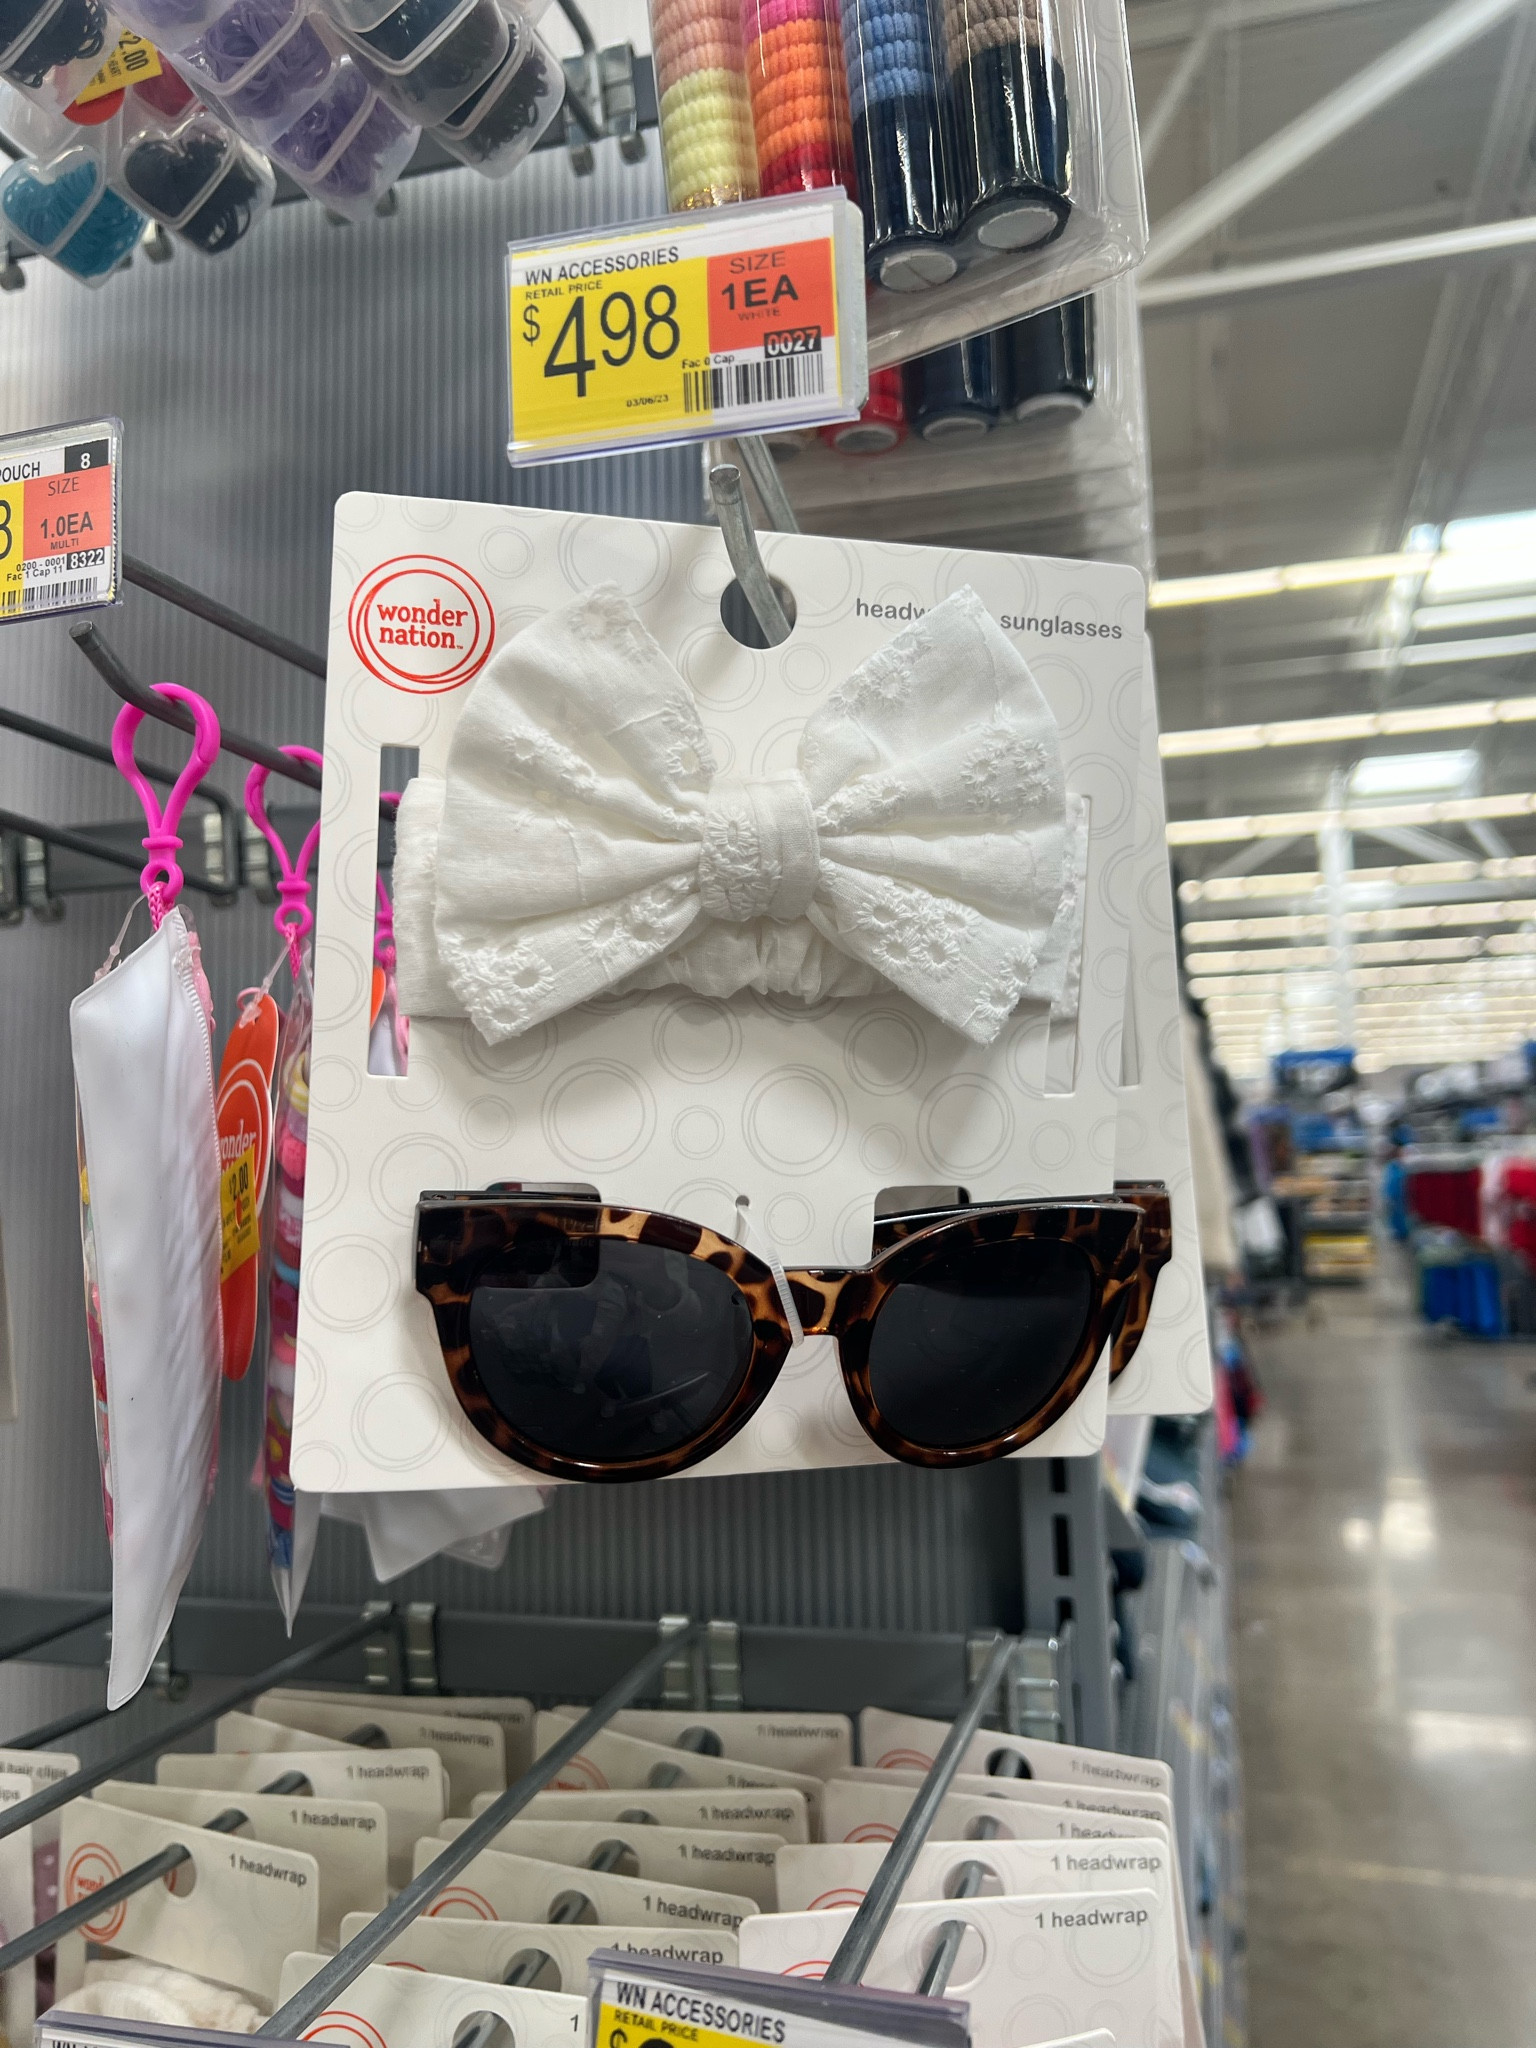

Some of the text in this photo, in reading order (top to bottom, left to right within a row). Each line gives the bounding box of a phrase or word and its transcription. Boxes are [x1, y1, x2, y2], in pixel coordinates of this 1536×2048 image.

[525, 246, 679, 286] WN ACCESSORIES
[729, 250, 786, 274] SIZE
[525, 280, 603, 300] RETAIL PRICE
[722, 274, 799, 310] 1EA
[738, 308, 781, 321] WHITE
[767, 329, 818, 356] 0027
[682, 358, 701, 369] Fac
[714, 354, 735, 366] Cap
[80, 452, 91, 470] 8
[48, 476, 80, 497] SIZE
[40, 511, 94, 539] 1.0EA
[50, 539, 79, 550] MULTI
[16, 561, 37, 572] 0200
[45, 556, 65, 567] 0001
[70, 548, 104, 569] 8322
[6, 572, 23, 582] Fac
[32, 568, 51, 578] Cap
[377, 598, 468, 627] wonder
[856, 597, 1123, 639] headw sunglasses
[219, 1118, 257, 1160] onder
[291, 1810, 377, 1832] 1 headwrap
[679, 1844, 776, 1867] 1 headwrap
[1050, 1854, 1161, 1873] 1 headwrap
[230, 1854, 307, 1887] 1 headwrap
[643, 1895, 743, 1931] 1 headwrap
[1034, 1909, 1148, 1929] 1 headwrap
[570, 2014, 579, 2033] 1
[616, 1981, 647, 2009] WN
[651, 1991, 785, 2044] ACCESSORIES
[614, 2009, 656, 2030] RETAIL
[661, 2020, 698, 2042] PRICE
